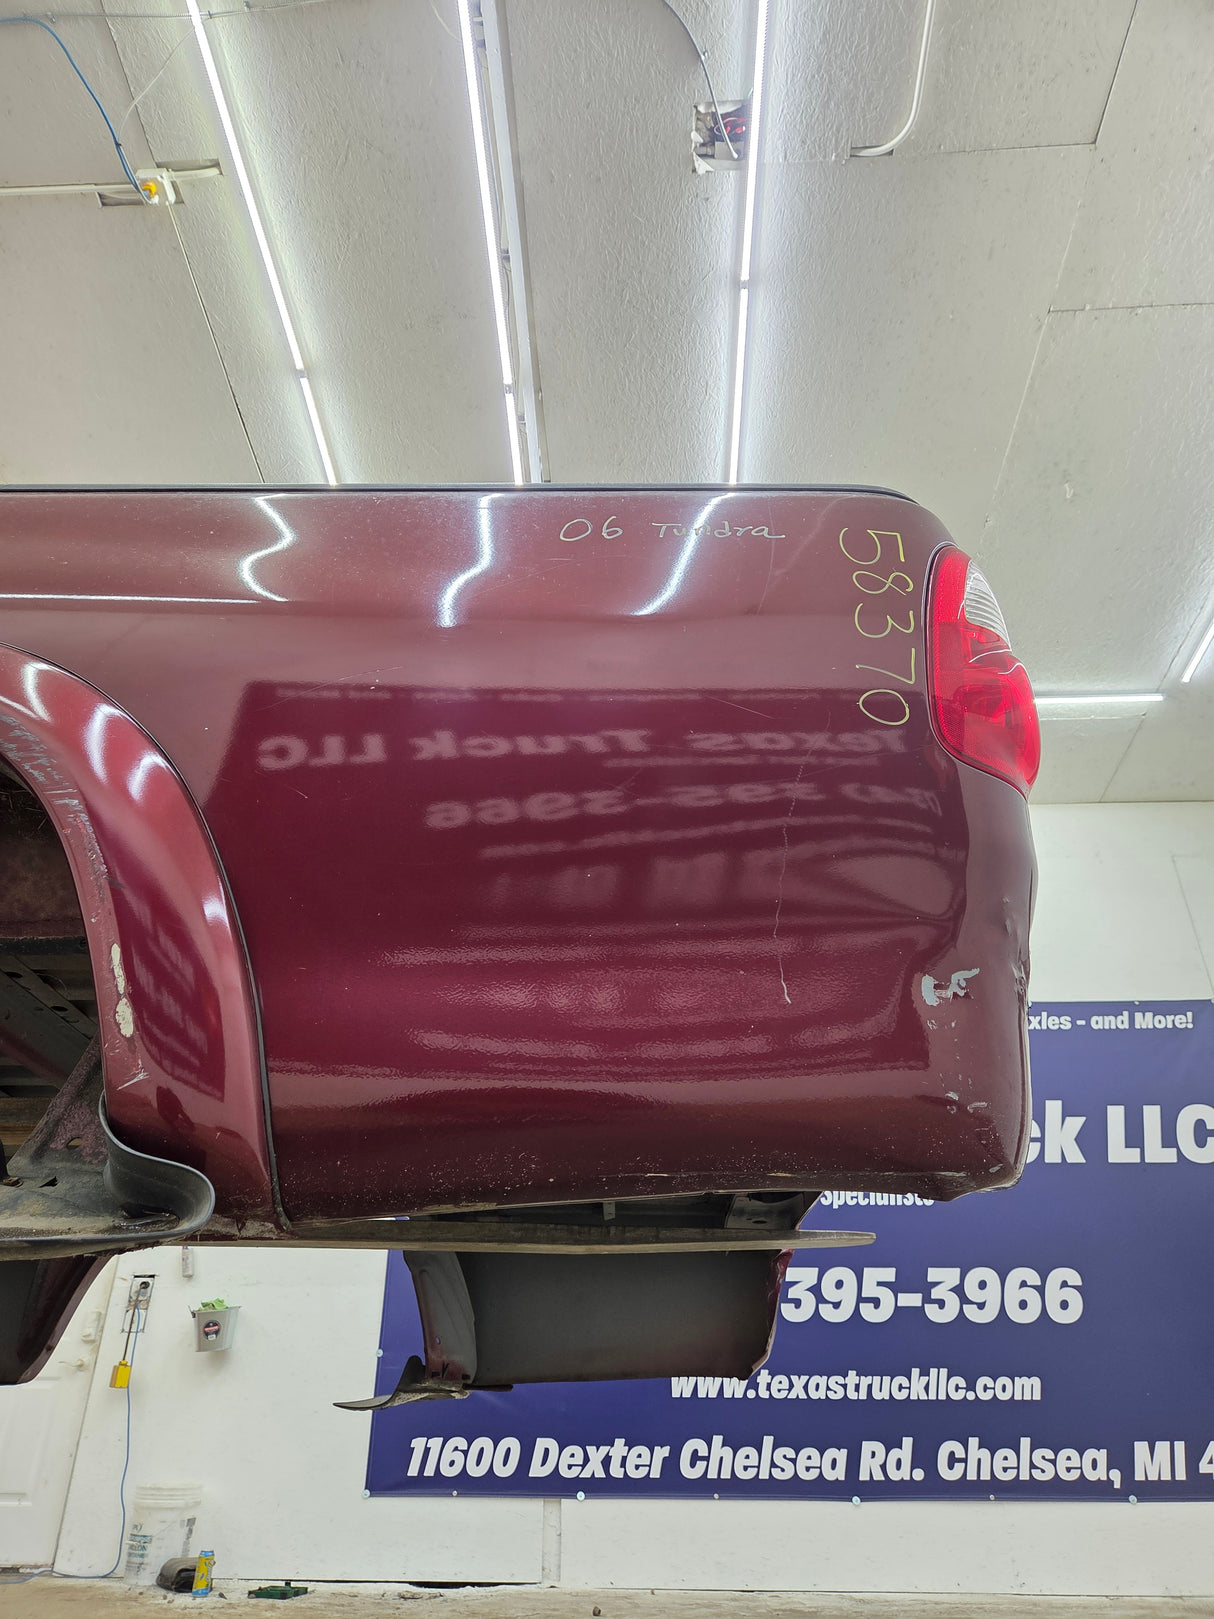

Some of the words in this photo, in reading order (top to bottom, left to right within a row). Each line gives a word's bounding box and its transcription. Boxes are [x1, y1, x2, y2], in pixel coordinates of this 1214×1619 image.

[560, 516, 623, 541] 06
[652, 520, 786, 539] Tundra
[840, 527, 915, 726] 58370
[1090, 1011, 1129, 1030] and
[1134, 1011, 1194, 1029] More!
[1107, 1103, 1214, 1164] LLC
[780, 1266, 1084, 1324] 395-3966
[670, 1368, 1041, 1401] www.texastruckllc.com
[406, 1437, 521, 1478] 11600
[528, 1437, 671, 1480] Dexter
[679, 1435, 848, 1482] Chelsea
[858, 1437, 926, 1482] Rd.
[937, 1437, 1121, 1489] Chelsea,
[1133, 1440, 1187, 1482] MI
